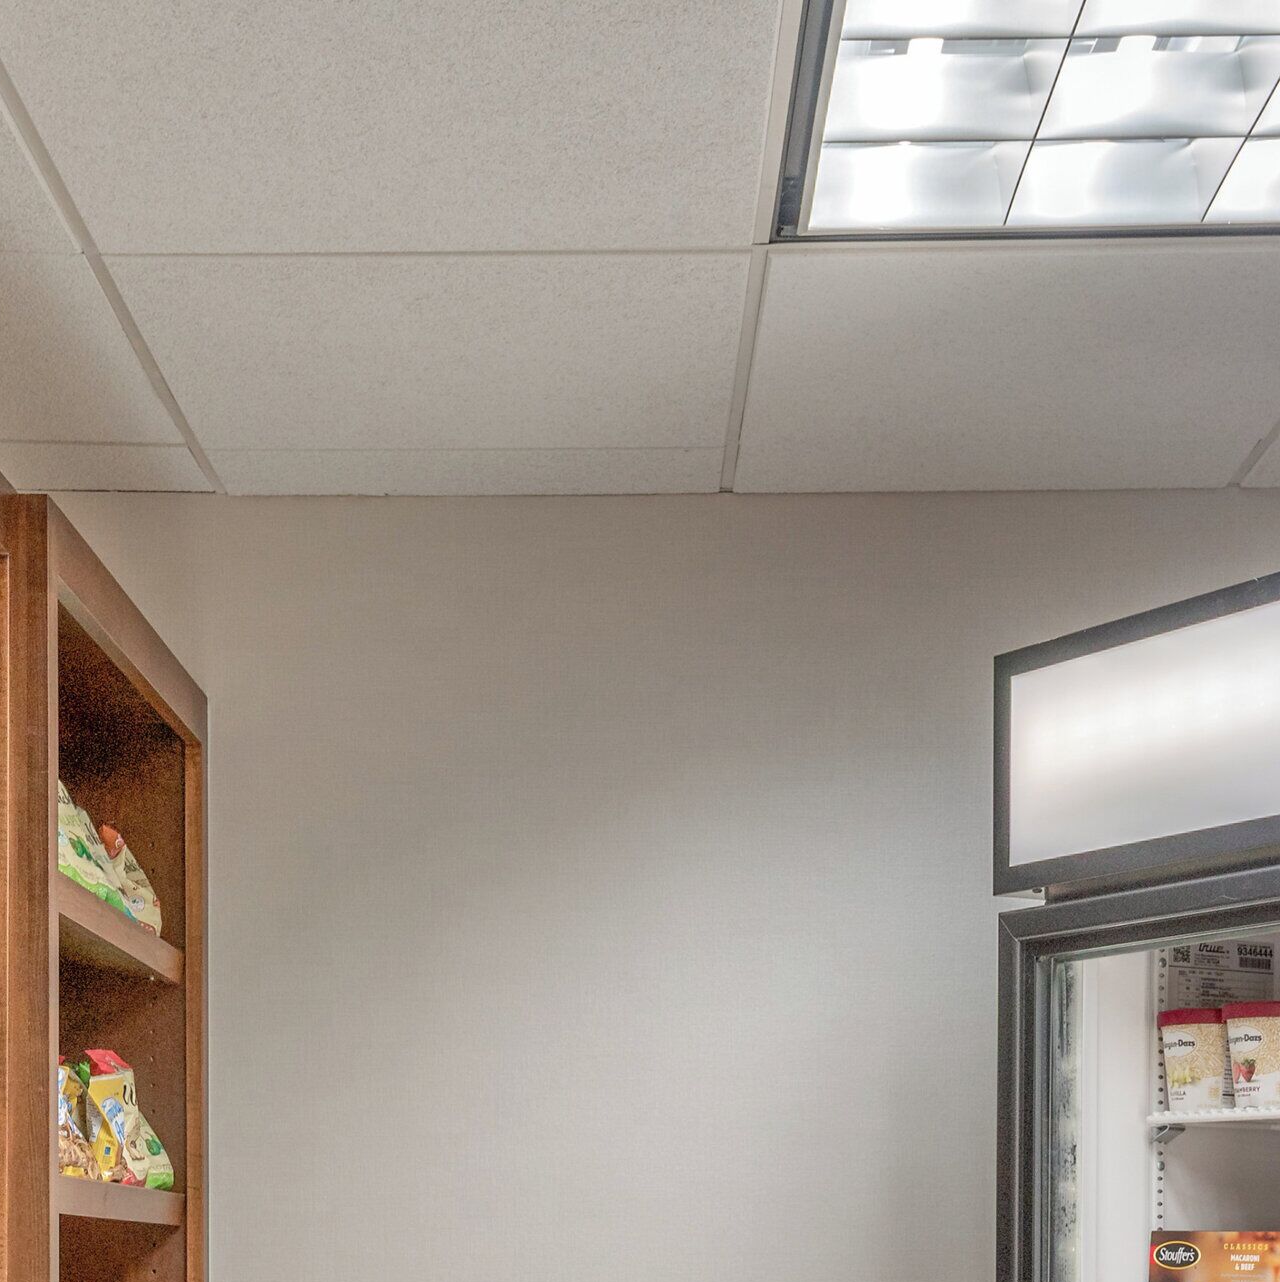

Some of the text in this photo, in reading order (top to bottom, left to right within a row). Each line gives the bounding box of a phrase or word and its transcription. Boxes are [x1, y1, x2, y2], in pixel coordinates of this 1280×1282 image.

[1224, 1243, 1269, 1251] CLASSICS
[1158, 1247, 1195, 1264] Stouffer's
[1230, 1254, 1260, 1263] MACARONI
